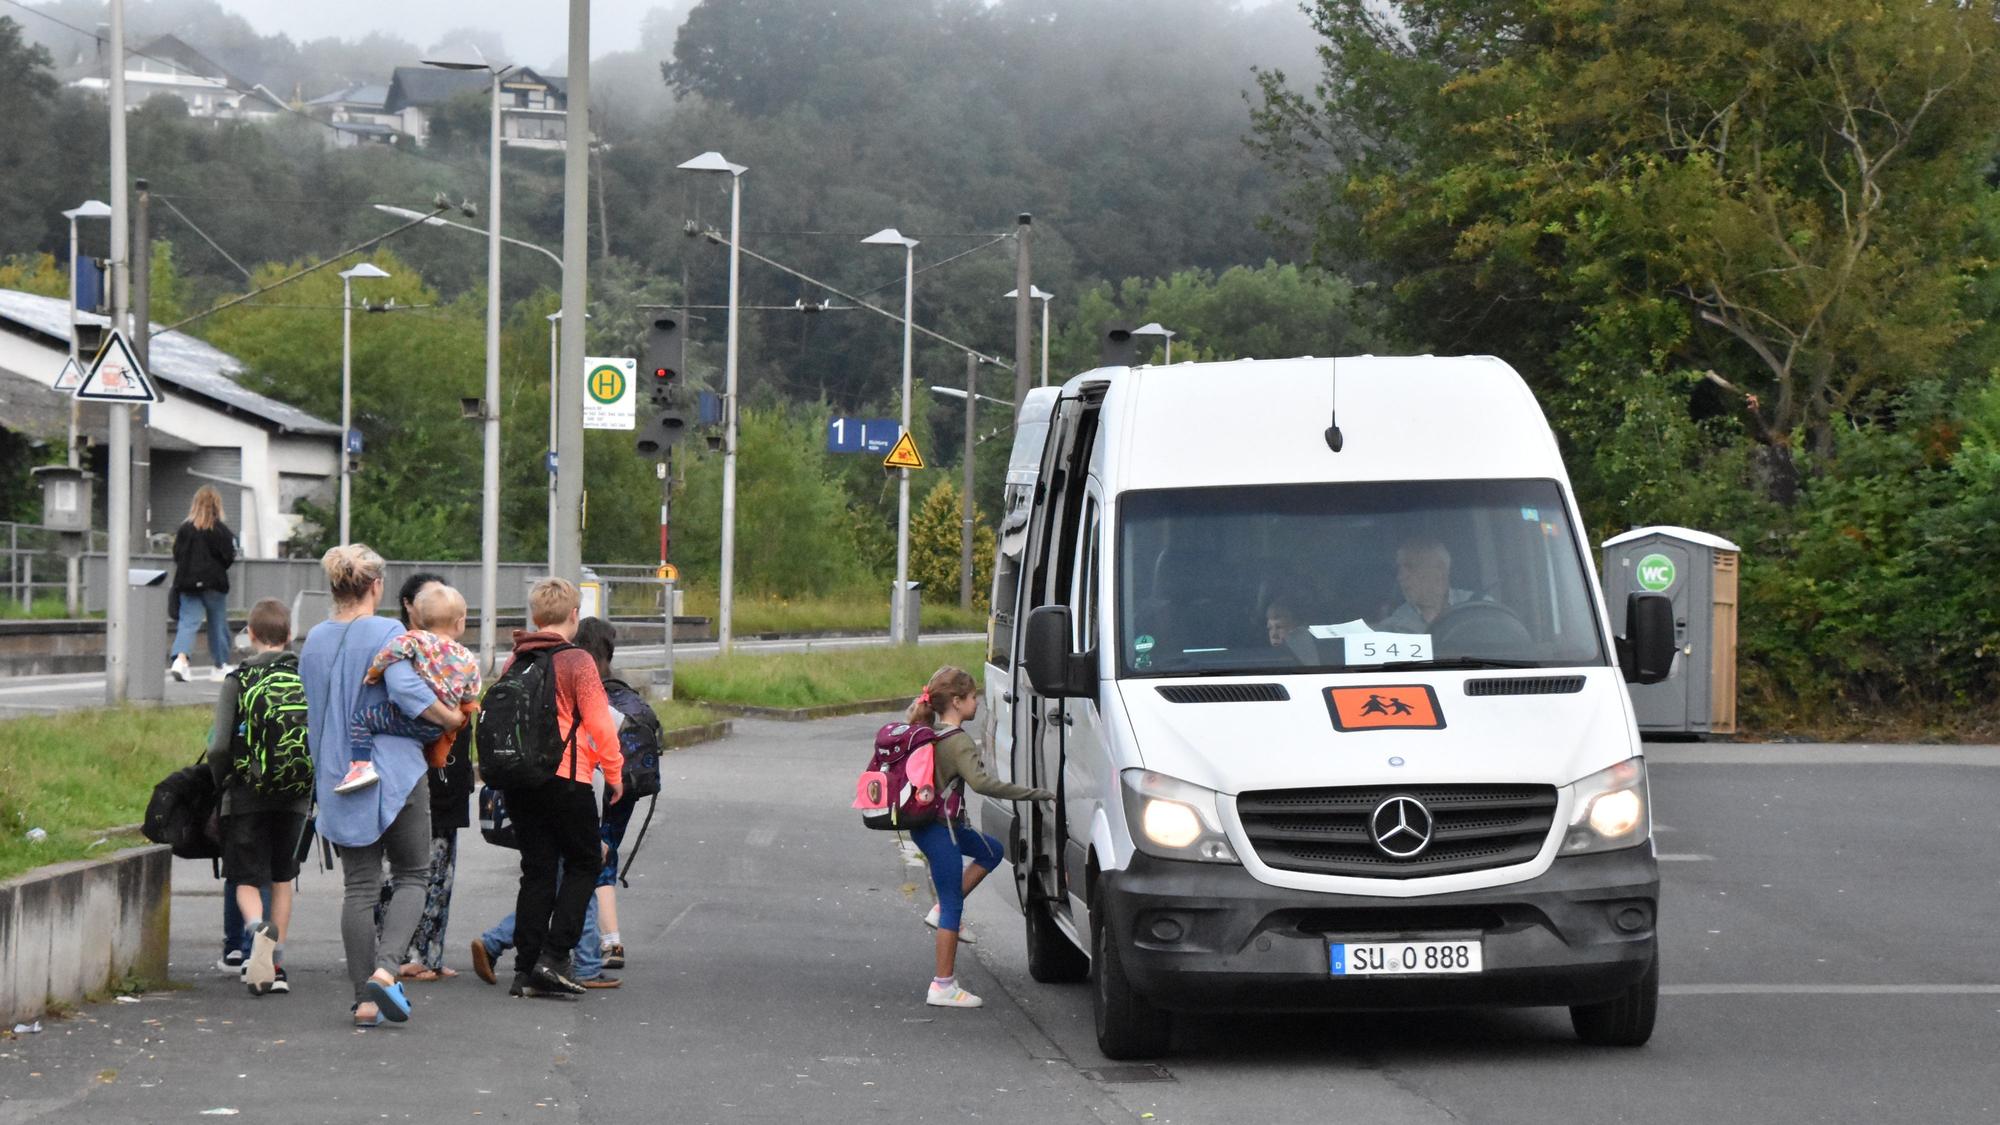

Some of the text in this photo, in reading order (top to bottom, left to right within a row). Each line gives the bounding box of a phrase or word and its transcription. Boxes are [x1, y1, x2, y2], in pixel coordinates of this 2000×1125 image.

[598, 373, 615, 396] H
[832, 418, 844, 445] 1
[1642, 566, 1669, 582] WC
[1353, 947, 1384, 970] SU
[1425, 945, 1470, 969] 888
